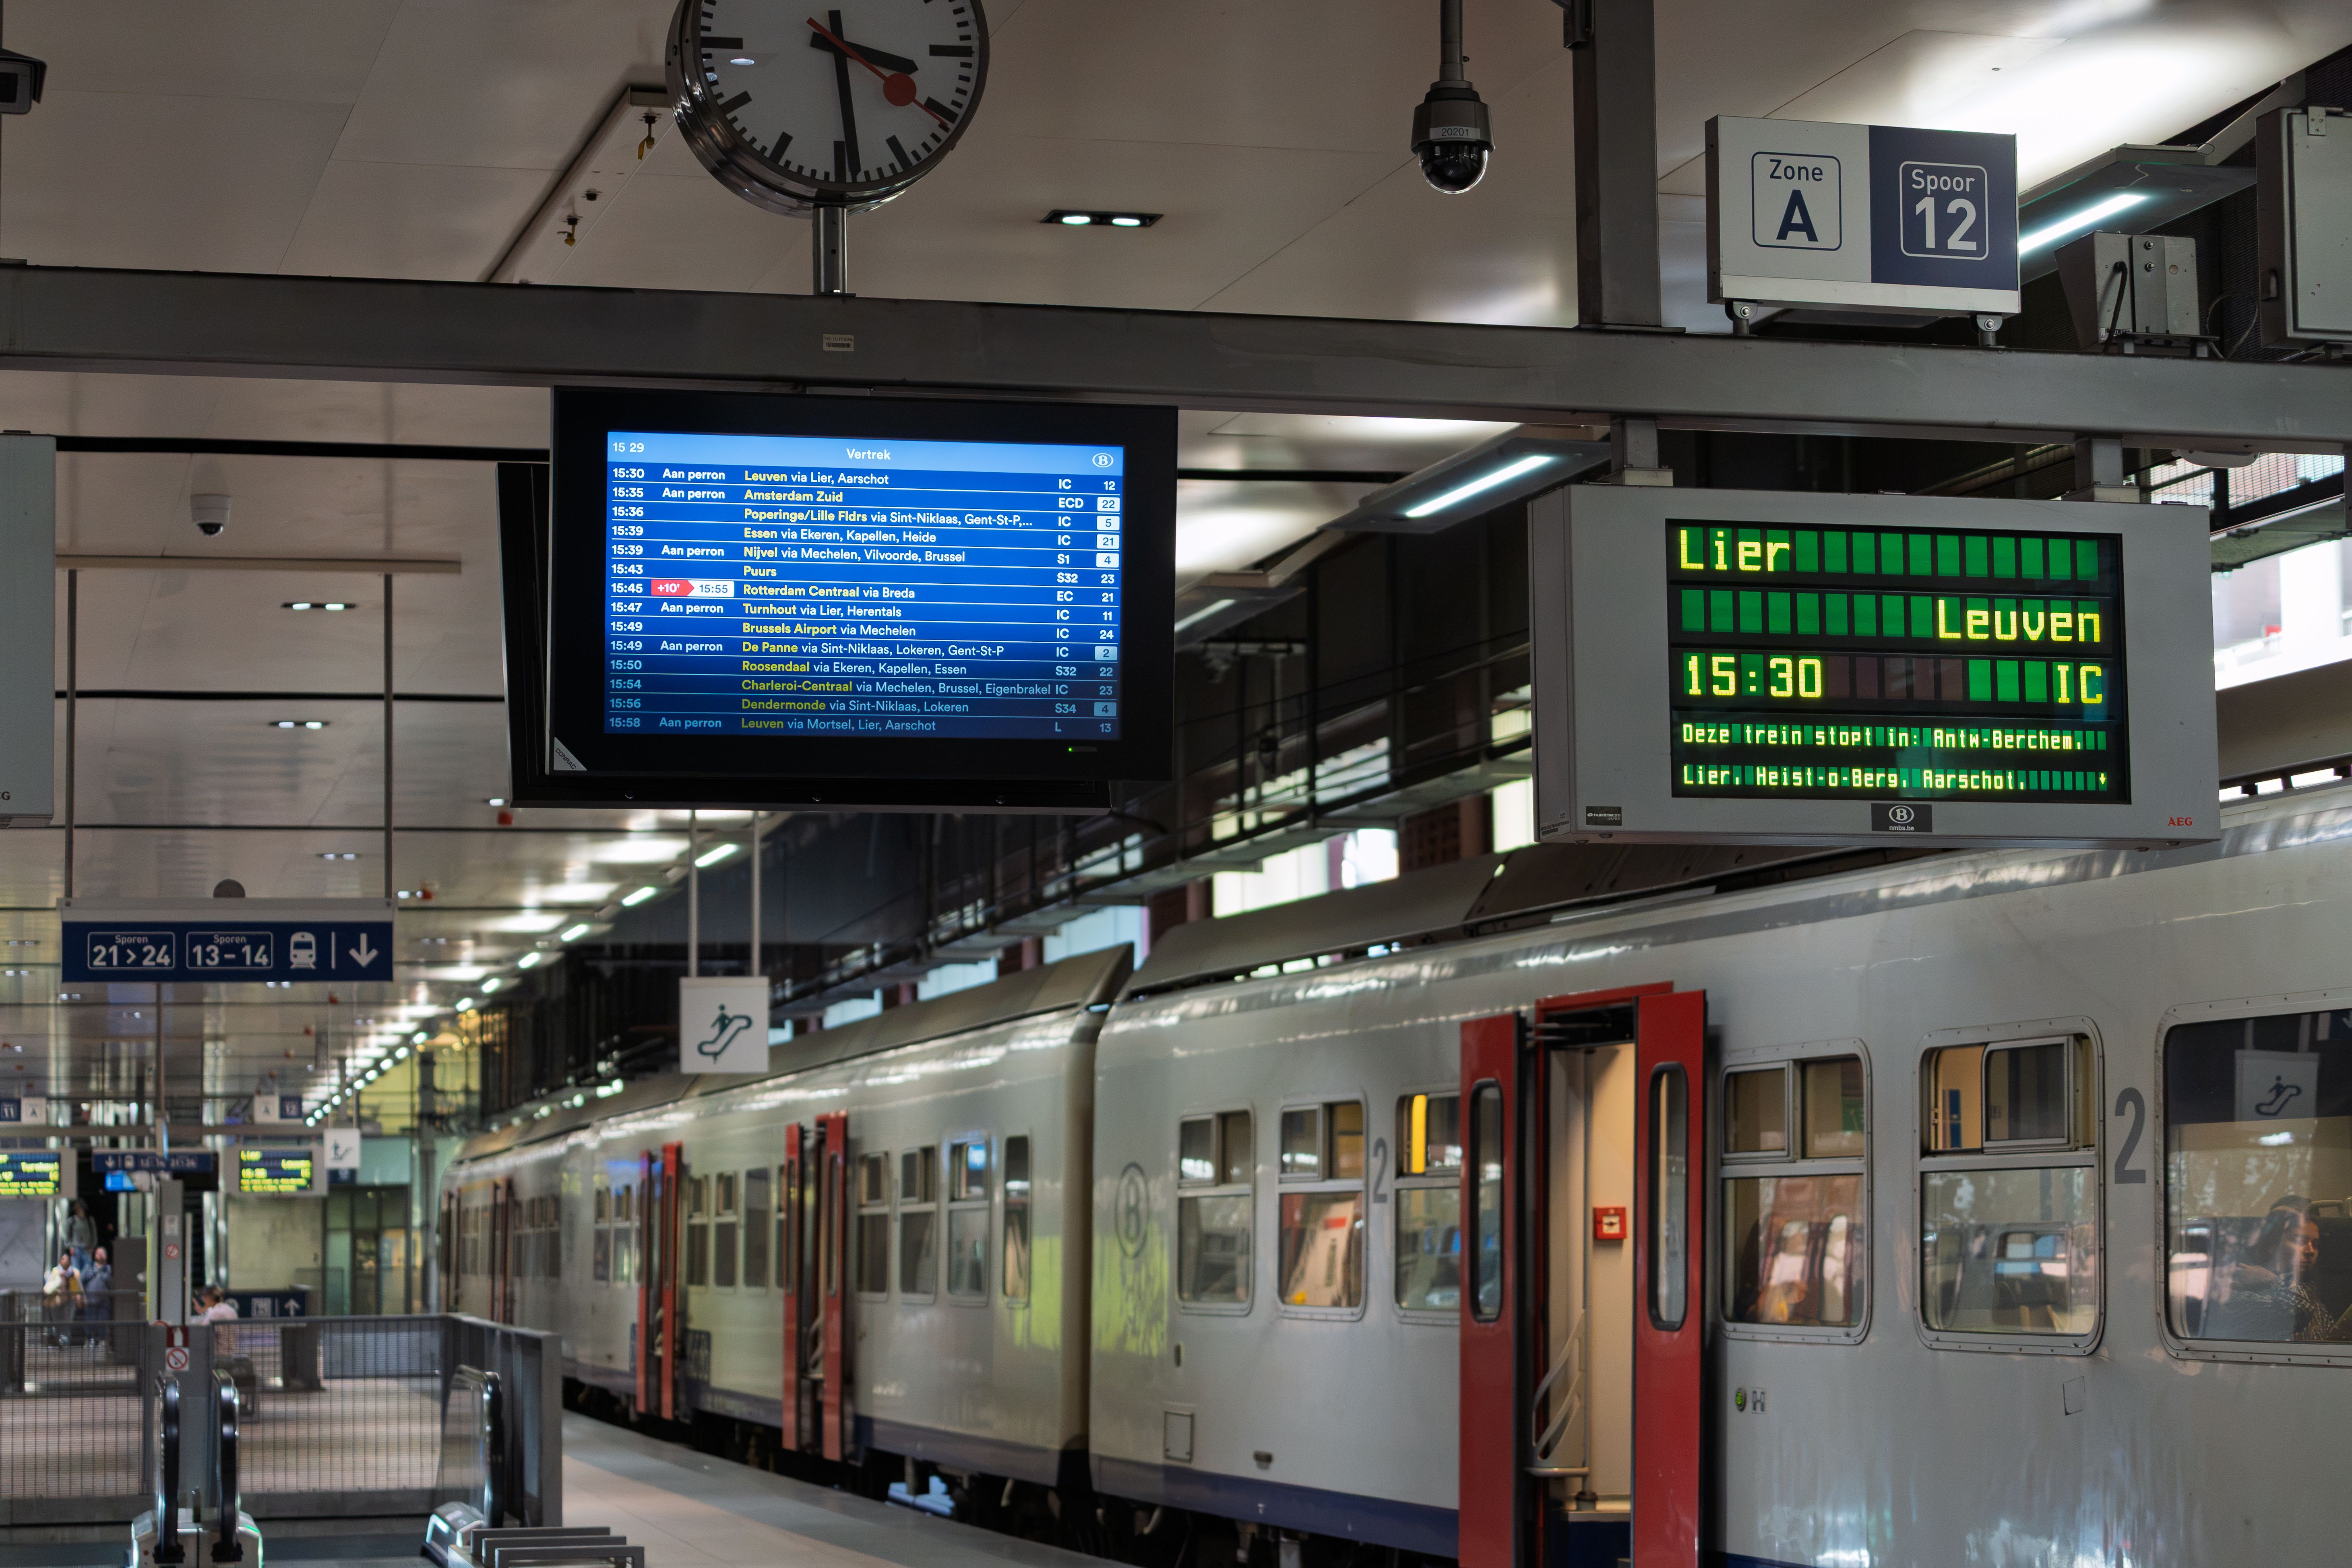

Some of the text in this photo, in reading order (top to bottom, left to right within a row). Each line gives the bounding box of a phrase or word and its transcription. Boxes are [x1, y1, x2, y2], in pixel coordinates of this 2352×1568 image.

[1442, 128, 1469, 136] 20201
[1769, 159, 1823, 181] Zone
[1912, 169, 1975, 194] Spoor
[1776, 189, 1818, 242] A
[1916, 197, 1977, 251] 12
[846, 448, 891, 460] Vertrek
[613, 468, 1116, 490] 15:30 Aan perron Leuven via Lier, Aarschot IC 12
[612, 487, 1115, 508] 15:35 Aan perron Amsterdam Zuid ECD 22
[612, 506, 644, 517] 15:36
[744, 508, 835, 523] Poperinge/Lille
[838, 510, 867, 522] Fldrs
[870, 511, 887, 523] via
[890, 512, 961, 526] Sint-Niklaas,
[1058, 516, 1071, 527] IC
[1105, 519, 1112, 527] 5
[612, 525, 1114, 546] 15:39 Essen via Ekeren, Kapellen, Heide IC 21
[612, 545, 1111, 564] 15:39 Aan perron Nijvel via Mechelen, Vilvoorde, Brussel S1 4
[1680, 529, 1790, 572] Lier
[611, 564, 1115, 584] 15:43 Puurs S32 23
[611, 583, 1114, 602] 15:45 +10' 15:55 Rotterdam Centraal via Breda EC 21
[611, 602, 1112, 621] 15:47 Aan perron Turnhout via Lier, Herentals IC 11
[1938, 599, 2100, 642] Leuven
[610, 621, 1114, 639] 15:49 Brussels Airport via Mechelen IC 24
[610, 640, 1109, 657] 15:49 Aan perron De Panne via Sint-Niklaas, Lokeren, Gent-St-P IC 2
[610, 660, 1113, 676] 15:50 Roosendaal via Ekeren, Kapellen, Essen S32 22
[610, 679, 1112, 696] 15:54 Charleroi-Centraal via Mechelen, Brussel, Eigenbrakel IC 23
[1688, 656, 2102, 704] 15:30 IC
[610, 698, 1108, 713] 15:56 Dendermonde via Sint-Niklaas, Lokeren S34 4
[610, 717, 1111, 732] 15:58 Aan perron Leuven via Mortsel, Lier, Aarschot L 13
[1683, 724, 2082, 750] Deze trein stopt in: Antw-Berchem,
[556, 748, 576, 769] CONRAC
[1683, 765, 2024, 790] Lier, Heist-o-Berg, Aarschot,
[2168, 817, 2193, 826] AEG
[115, 935, 148, 945] Sporen
[213, 934, 246, 944] Sporen
[2114, 1087, 2146, 1184] 2
[1372, 1137, 1387, 1203] 2
[1752, 1390, 1765, 1411] H
